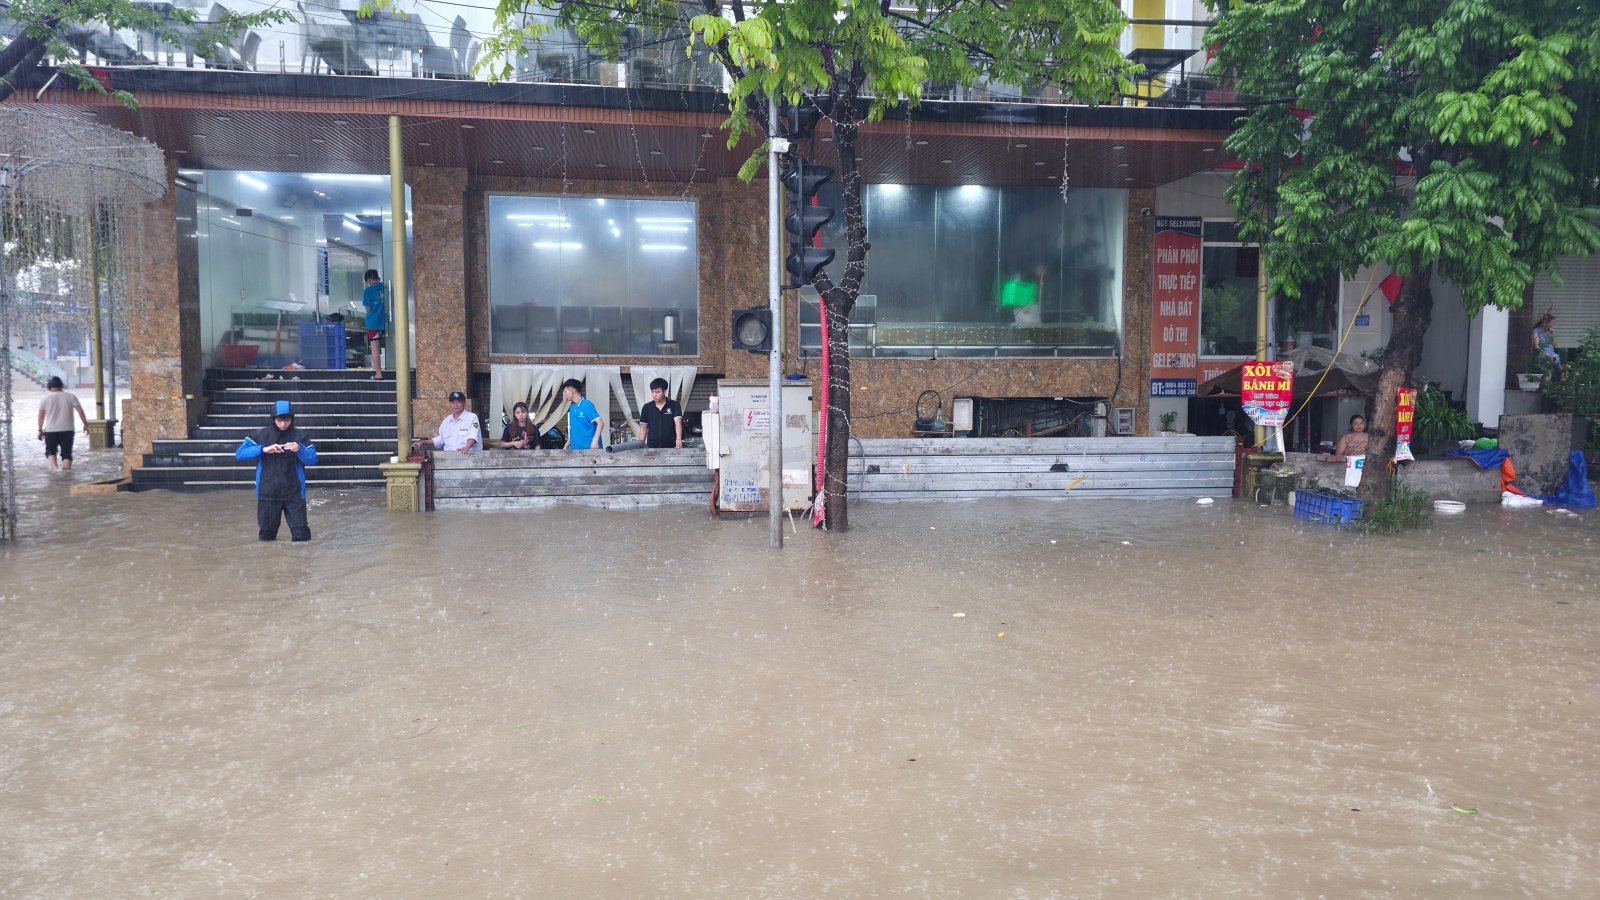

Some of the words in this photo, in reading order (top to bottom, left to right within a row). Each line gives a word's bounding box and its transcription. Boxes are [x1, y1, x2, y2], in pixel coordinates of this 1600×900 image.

[1169, 220, 1201, 228] GELEXIMCO
[1157, 245, 1178, 264] PHÂN
[1180, 243, 1199, 264] PHỐI
[1158, 274, 1178, 293] TRỰC
[1180, 270, 1197, 290] TIẾP
[1160, 298, 1176, 316] NHÀ
[1178, 296, 1193, 316] ĐẤT
[1163, 324, 1174, 342] ĐÔ
[1175, 327, 1188, 346] THỊ
[1243, 363, 1272, 377] XÔI
[1151, 382, 1165, 395] ĐT:
[1243, 379, 1275, 391] BÁNH
[1277, 379, 1291, 391] MÌ
